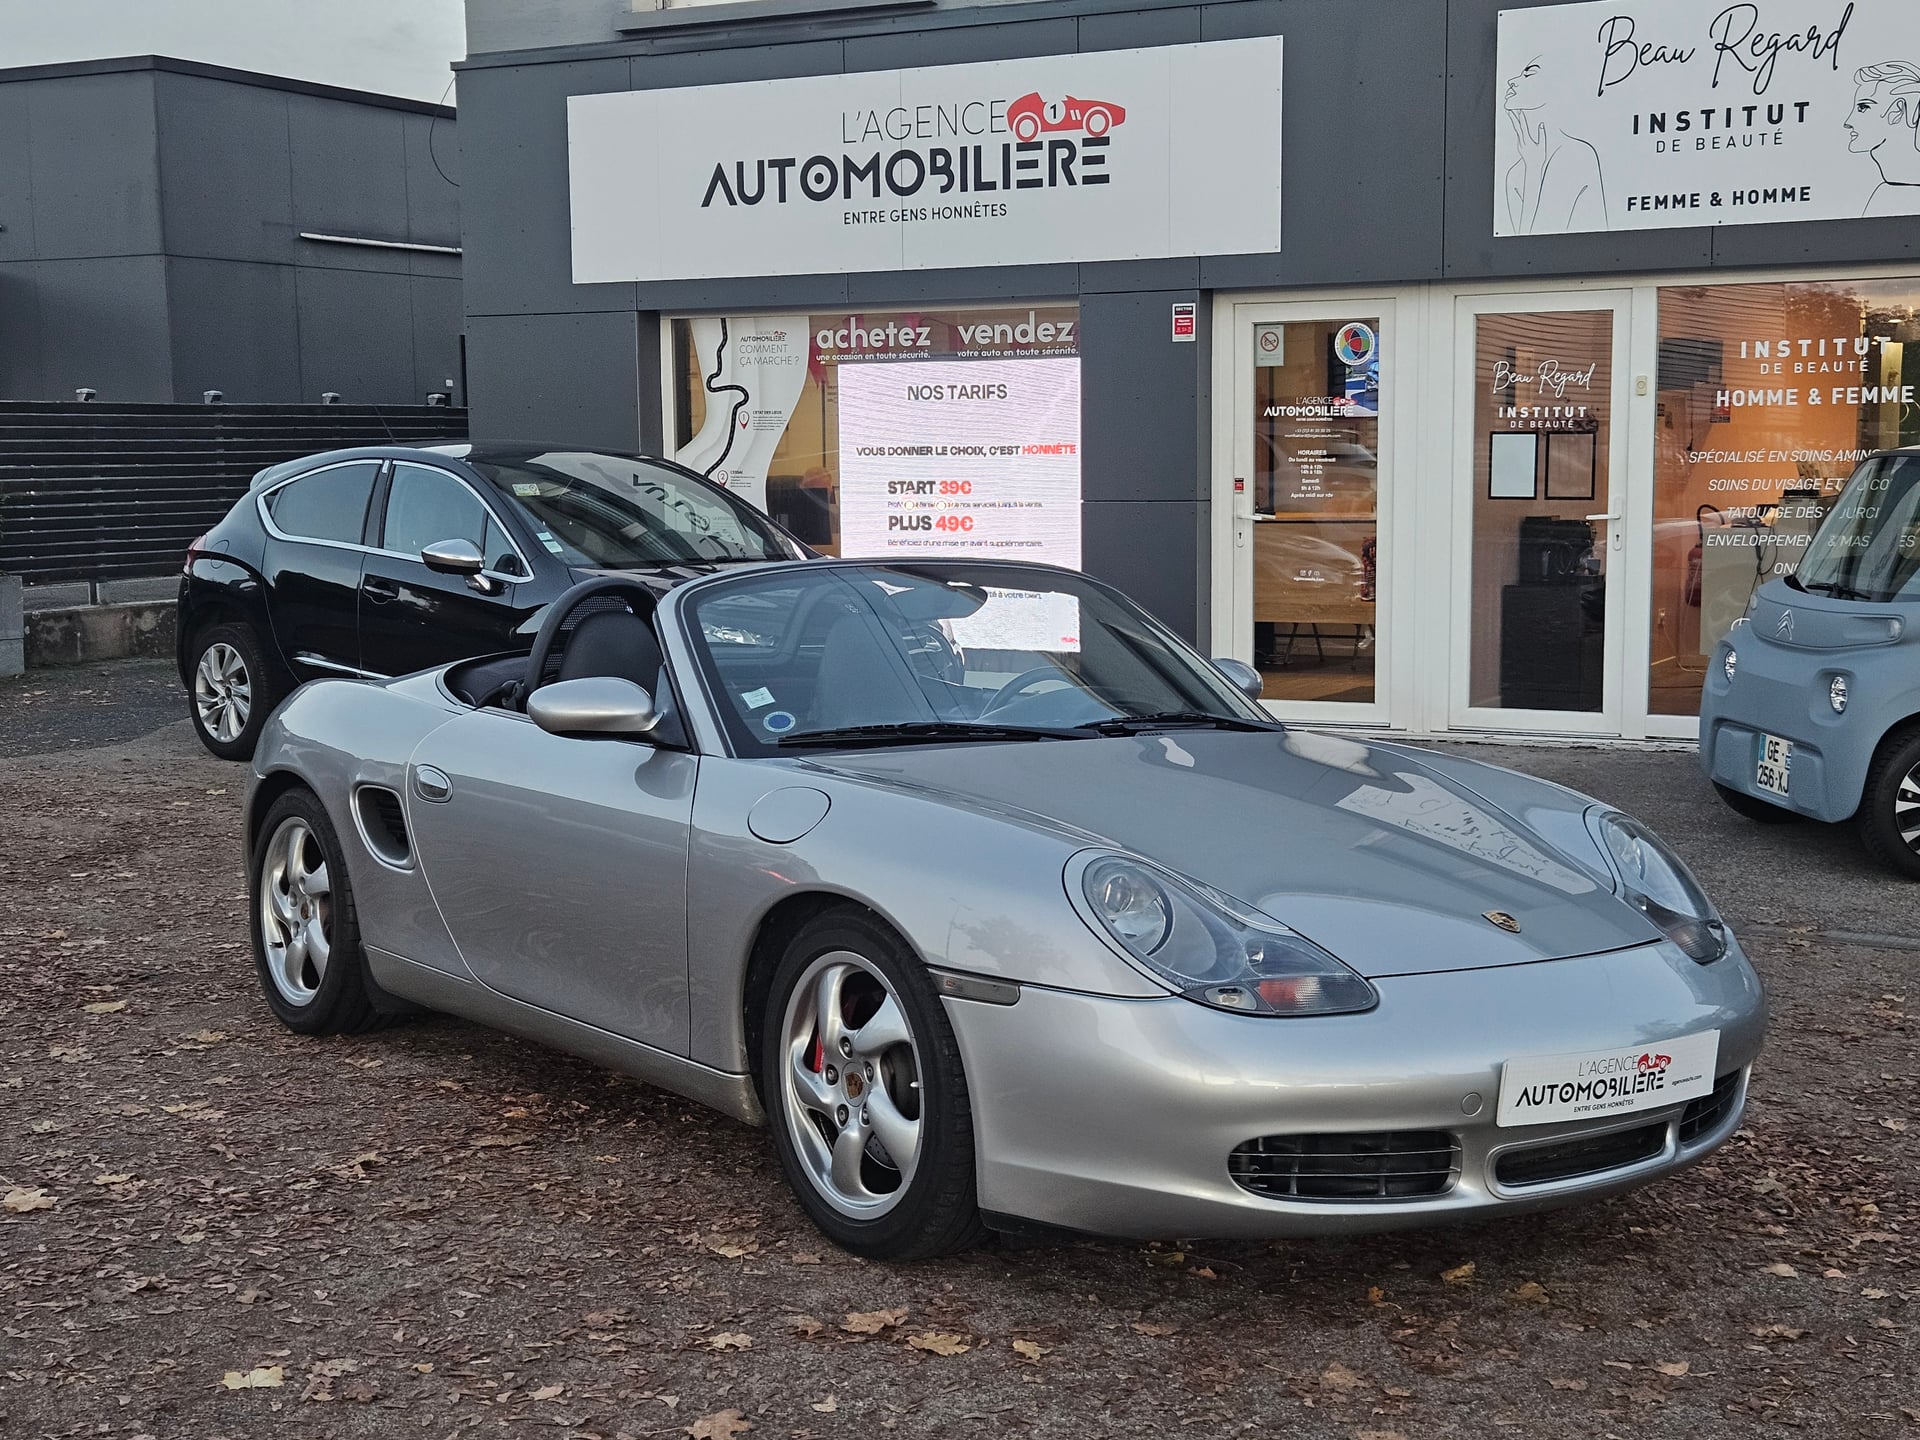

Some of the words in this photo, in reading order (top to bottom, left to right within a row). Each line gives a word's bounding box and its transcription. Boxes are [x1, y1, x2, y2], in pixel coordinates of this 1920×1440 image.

[1598, 15, 1696, 97] Beau
[1709, 2, 1854, 95] Regard
[842, 99, 1007, 144] L'AGENCE
[1632, 101, 1811, 135] INSTITUT
[1655, 139, 1681, 153] DE
[1695, 128, 1784, 151] BEAUTÉ
[1627, 192, 1701, 212] FEMME
[1709, 192, 1723, 207] &
[1732, 186, 1812, 206] HOMME
[843, 211, 885, 225] ENTRE
[889, 207, 927, 222] GENS
[931, 201, 1007, 219] HONNÊTES
[816, 317, 931, 349] achetez
[957, 311, 1075, 345] vendez
[739, 344, 789, 354] COMMENT
[957, 349, 979, 358] votre
[981, 349, 1001, 357] auto
[1016, 347, 1040, 357] toute
[1740, 336, 1892, 359] INSTITUT
[739, 356, 752, 368] ÇA
[753, 355, 793, 366] MARCHE
[815, 354, 831, 362] une
[832, 352, 864, 361] occasion
[876, 351, 897, 360] toute
[1760, 363, 1782, 375] DE
[1794, 357, 1869, 374] BEAUTÉ
[1492, 361, 1534, 394] Beau
[1538, 360, 1595, 398] Regard
[907, 385, 944, 401] NOS
[947, 384, 1008, 400] TARIFS
[1296, 396, 1333, 405] L'AGENCE
[1716, 388, 1798, 407] HOMME
[1808, 388, 1822, 405] &
[1831, 385, 1915, 405] FEMME
[1498, 406, 1587, 418] INSTITUT
[1510, 420, 1524, 428] DE
[1530, 418, 1574, 429] BEAUTÉ
[856, 446, 886, 457] VOUS
[888, 446, 934, 456] DONNER
[935, 446, 948, 456] LE
[950, 445, 987, 458] CHOIX,
[989, 445, 1021, 456] C'EST
[1689, 448, 1765, 464] SPÉCIALISÉ
[1767, 450, 1787, 462] EN
[1790, 449, 1832, 462] SOINS
[888, 480, 936, 495] START
[939, 480, 972, 495] 39€
[1708, 479, 1749, 492] SOINS
[1752, 479, 1772, 491] DU
[1775, 478, 1823, 491] VISAGE
[1825, 477, 1846, 490] ET
[1727, 506, 1794, 519] TATOUAGE
[1796, 506, 1824, 519] DES
[888, 515, 932, 531] PLUS
[935, 515, 974, 531] 49€
[1707, 534, 1813, 547] ENVELOPPEMEN
[1578, 1053, 1639, 1077] L'AGENCE
[1573, 1104, 1591, 1113] ENTRE
[1592, 1103, 1607, 1111] GENS
